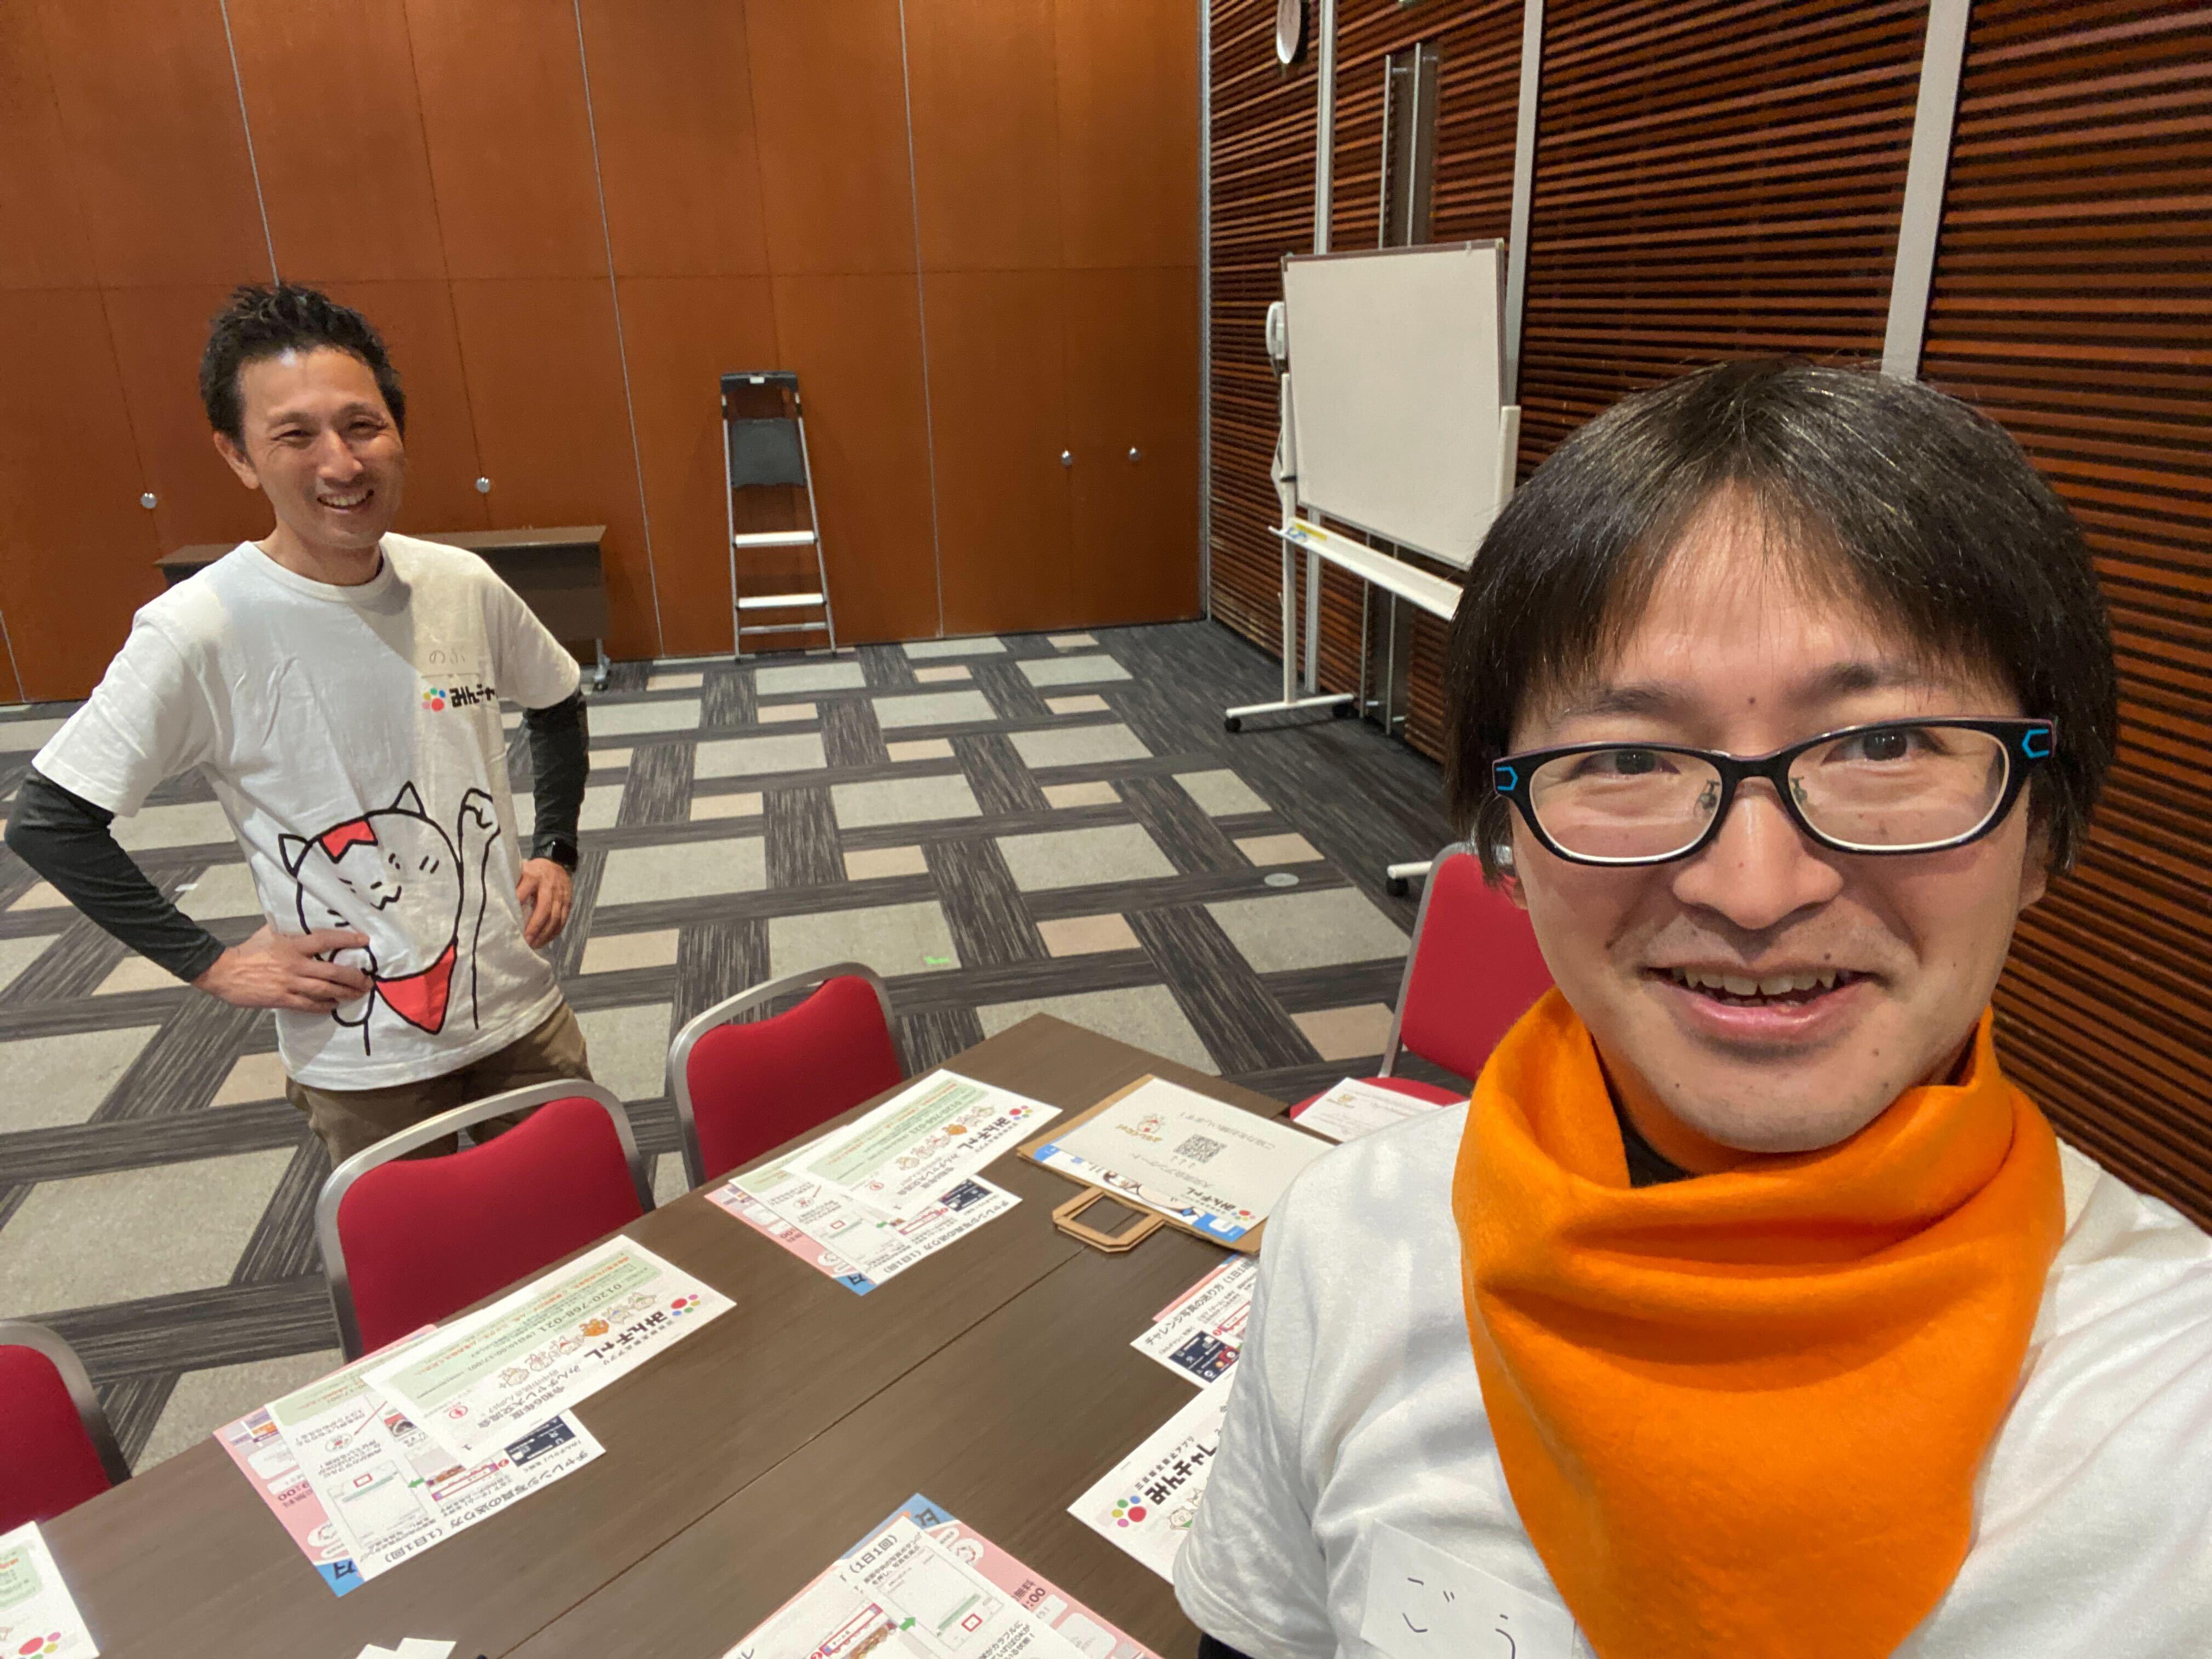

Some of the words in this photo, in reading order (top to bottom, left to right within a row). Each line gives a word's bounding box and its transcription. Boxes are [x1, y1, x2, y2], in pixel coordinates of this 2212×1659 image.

[449, 683, 498, 708] みんチャ
[956, 1116, 1013, 1152] みんチャレ
[1182, 1186, 1237, 1212] みんチャレ
[536, 1283, 624, 1333] 0120-768-021
[583, 1311, 669, 1363] みんチャレ
[475, 1365, 583, 1430] みんチャレ大交流会
[509, 1385, 567, 1420] 令和6年度
[1143, 1444, 1217, 1508] みんチャレ
